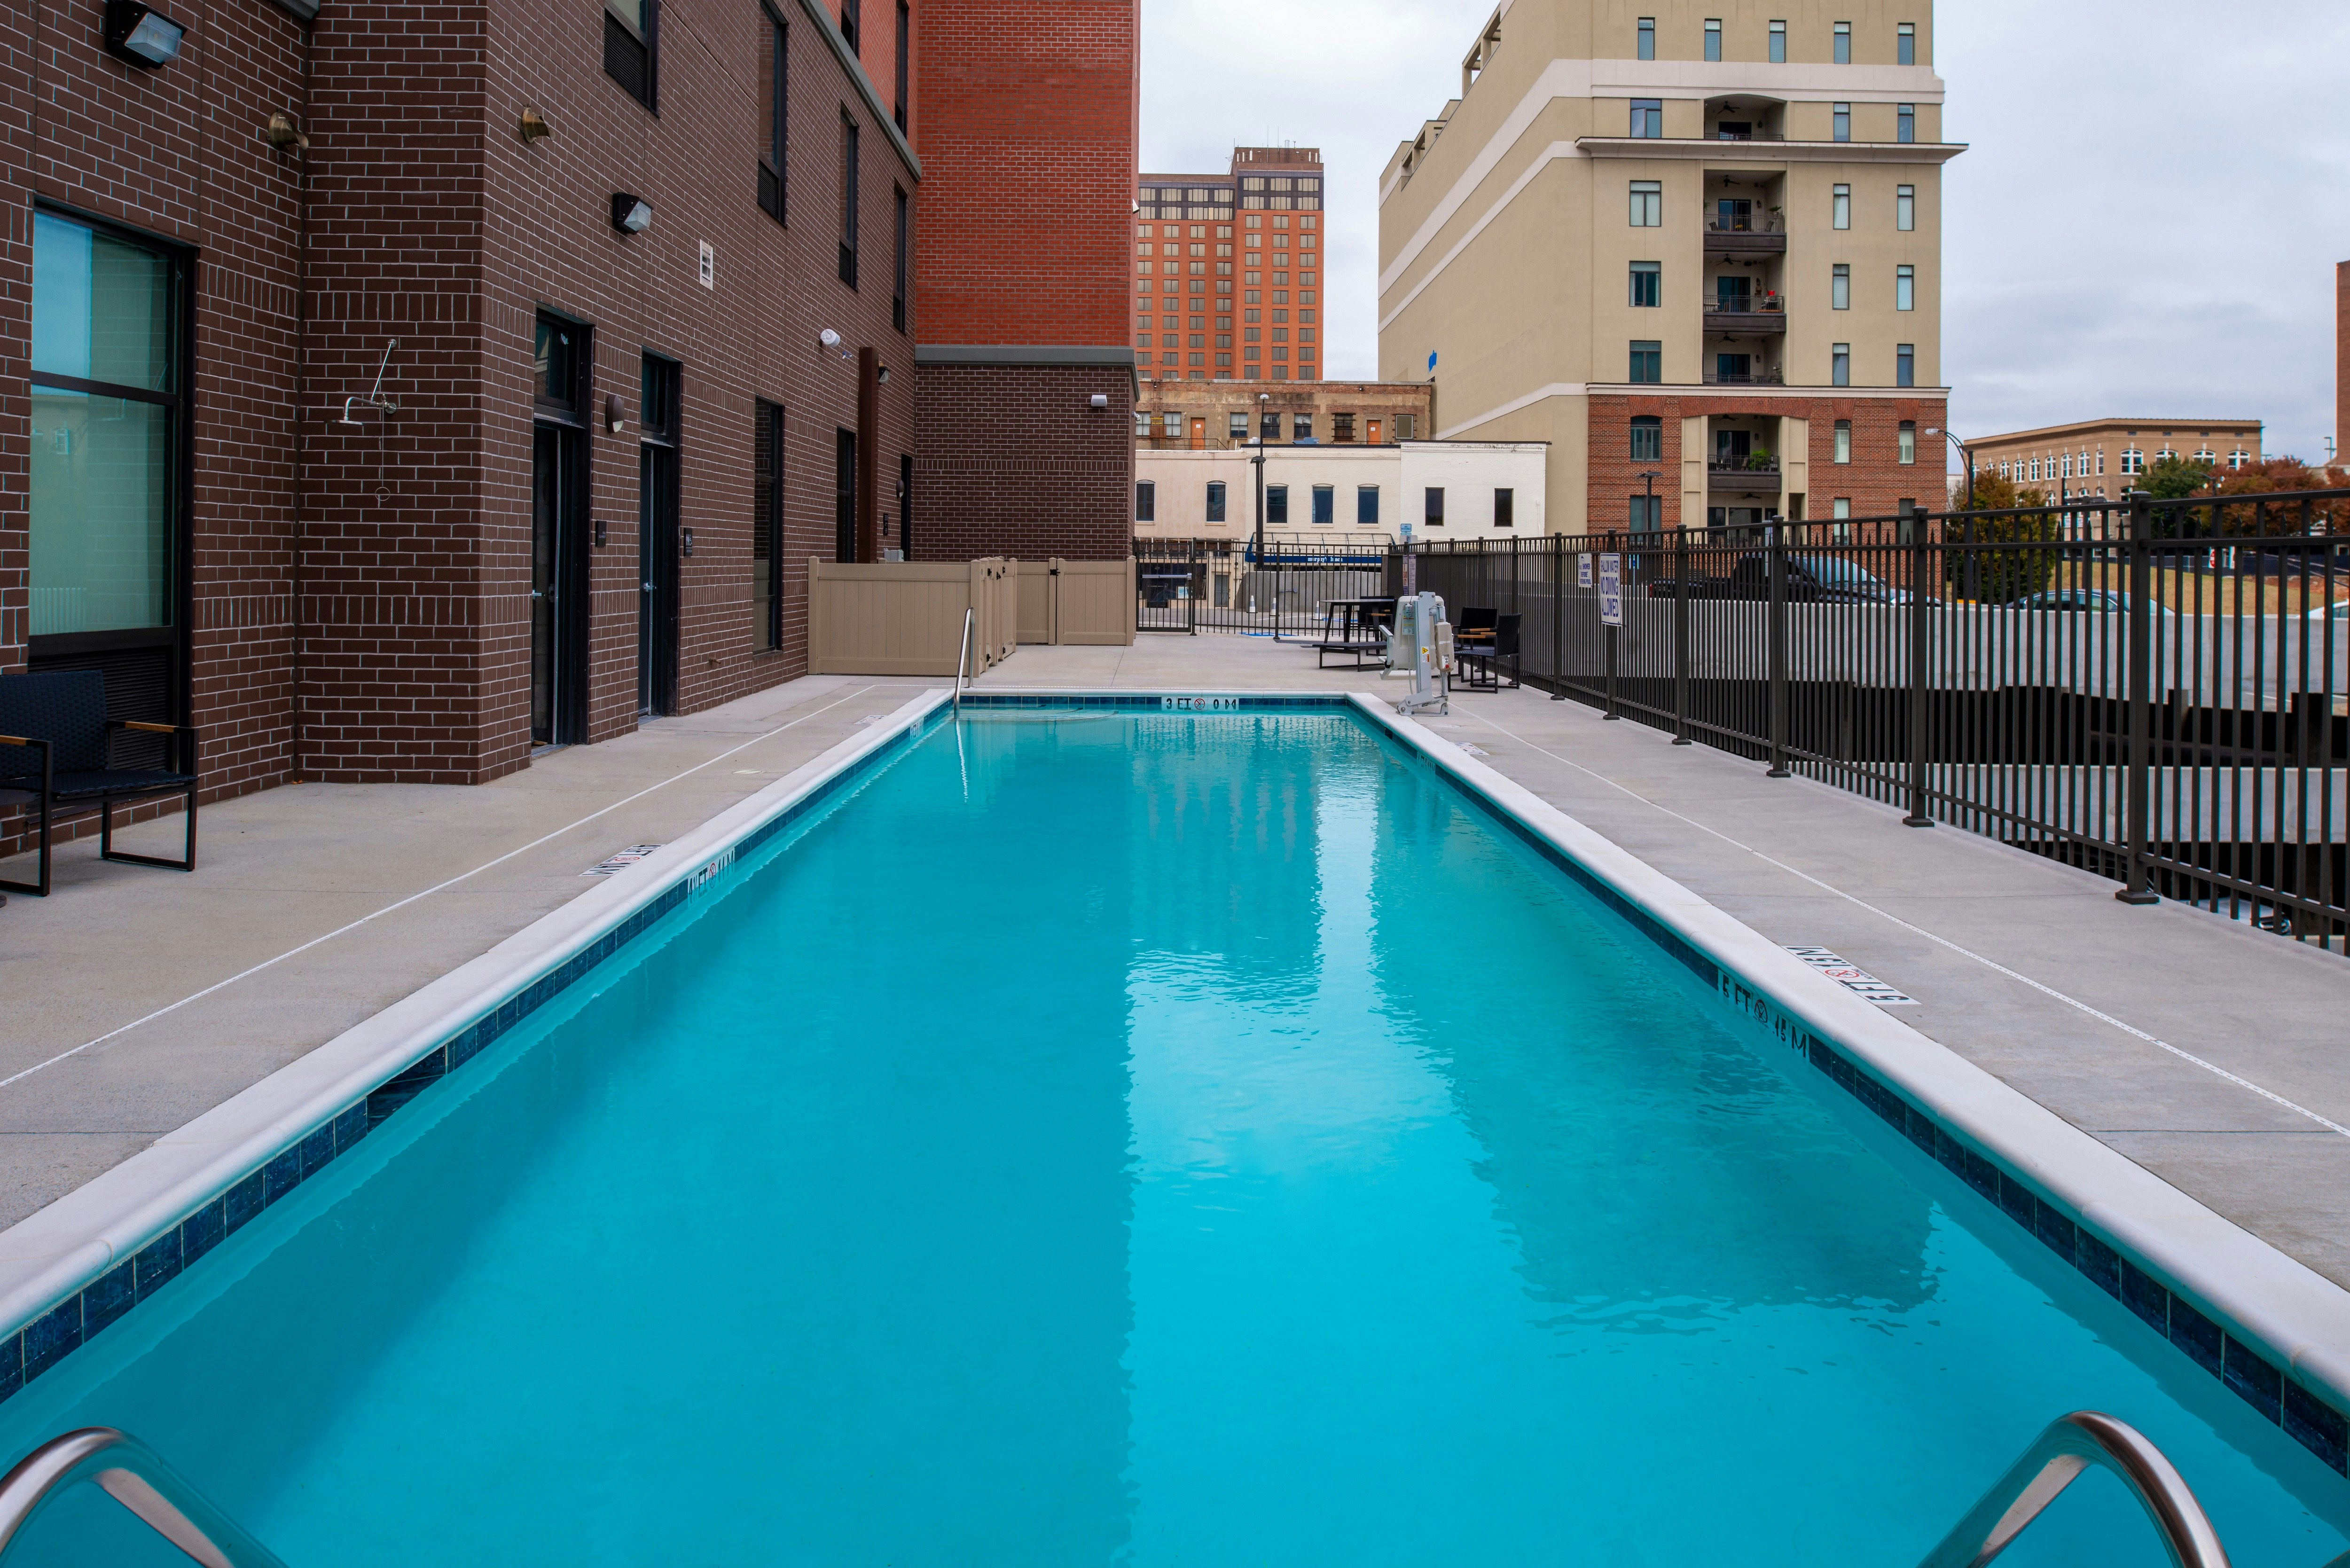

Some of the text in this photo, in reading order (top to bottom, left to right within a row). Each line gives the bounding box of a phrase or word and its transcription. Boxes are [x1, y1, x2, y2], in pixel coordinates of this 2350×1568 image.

[1601, 560, 1618, 573] SHALLOW WATER
[1601, 576, 1618, 596] NO DIVING
[1602, 597, 1619, 617] ALLOWED
[698, 867, 708, 889] FT
[1786, 947, 1833, 956] M
[1838, 980, 1895, 991] FT
[1723, 974, 1729, 998] 5
[1735, 982, 1751, 1013] FT
[1792, 1025, 1807, 1058] M
